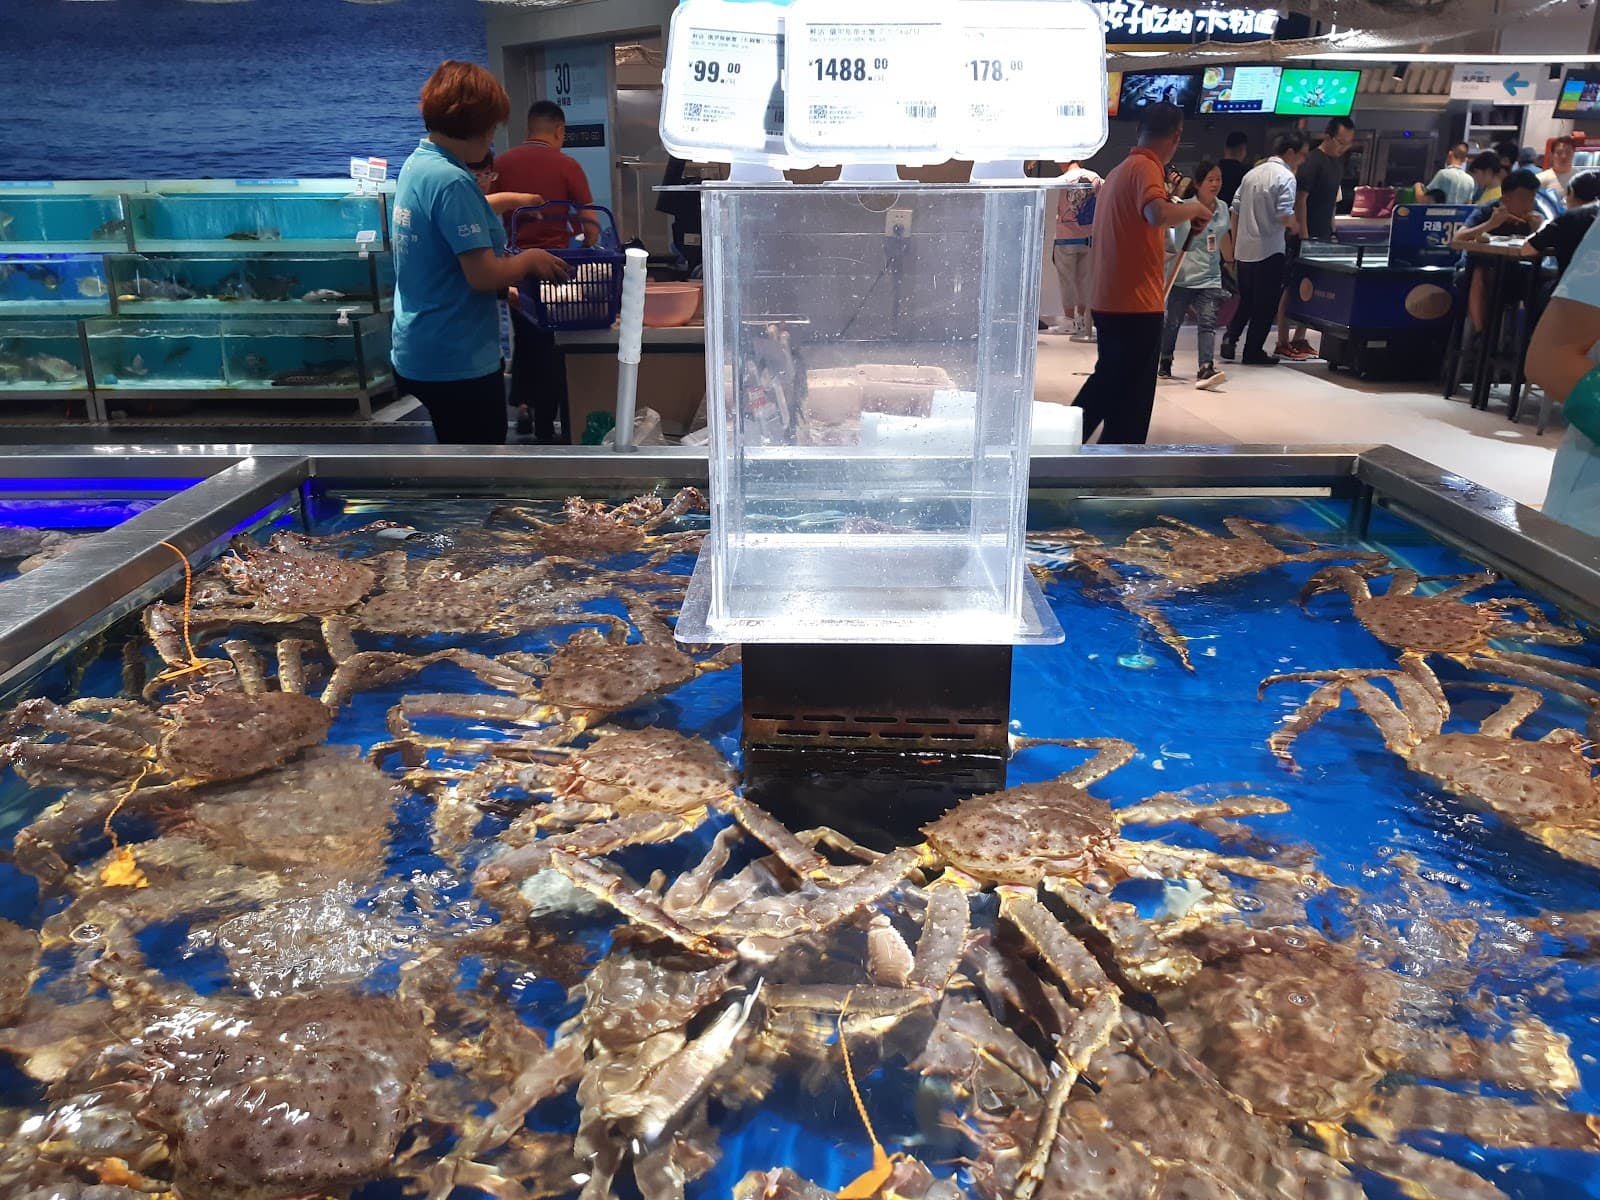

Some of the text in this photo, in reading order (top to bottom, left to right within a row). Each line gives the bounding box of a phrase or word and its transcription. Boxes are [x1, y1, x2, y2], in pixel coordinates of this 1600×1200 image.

[1097, 0, 1279, 35] 好吃的米粉面
[554, 62, 571, 95] 30
